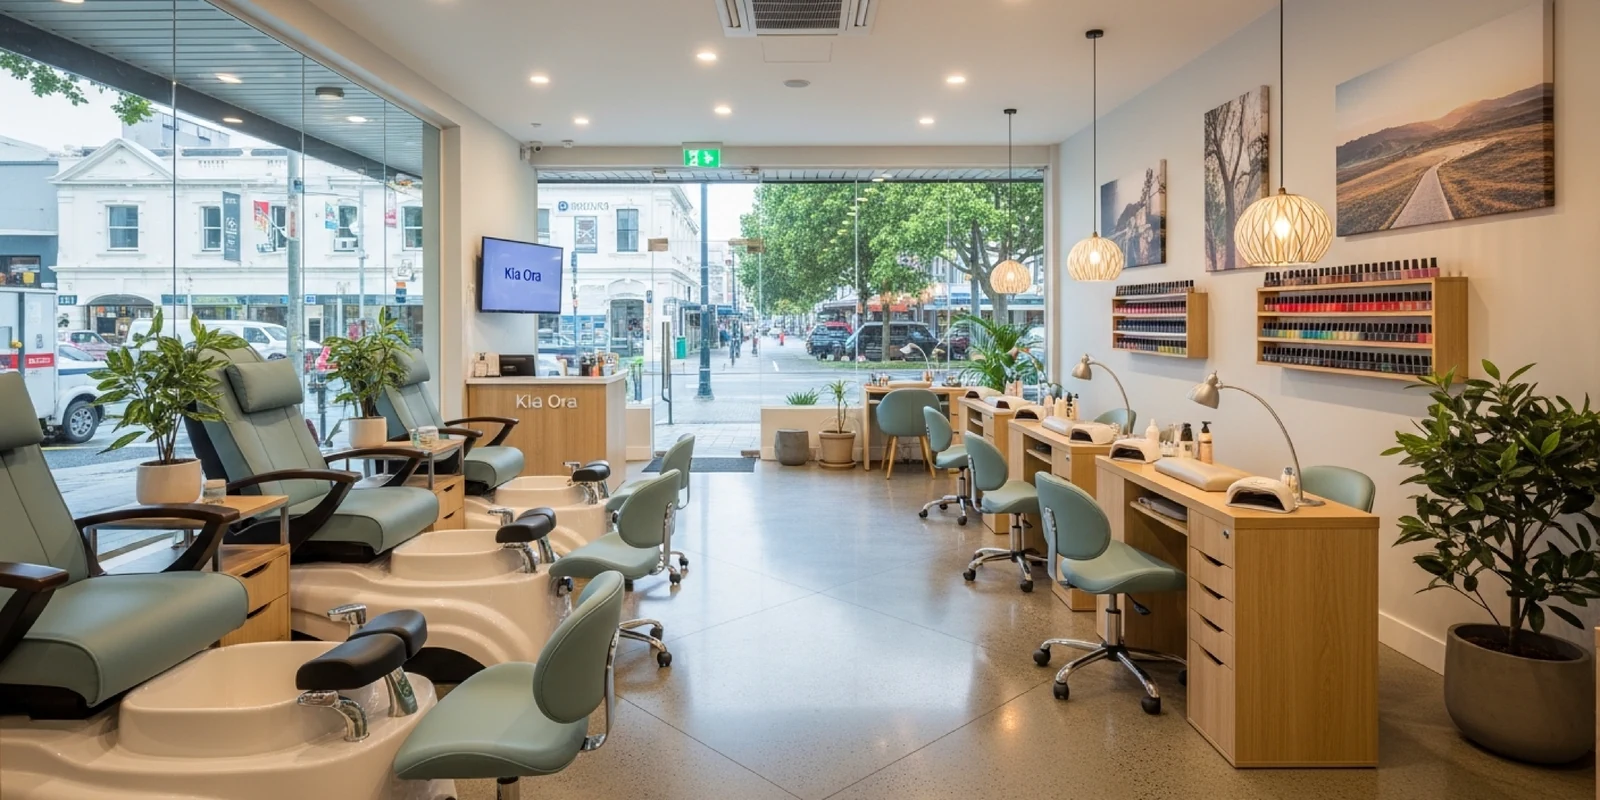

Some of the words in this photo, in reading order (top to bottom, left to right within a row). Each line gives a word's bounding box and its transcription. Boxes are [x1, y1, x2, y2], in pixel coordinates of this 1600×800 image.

[505, 267, 521, 280] Kia
[523, 269, 541, 282] Ora
[516, 394, 542, 408] Kia
[548, 394, 577, 409] Ora
